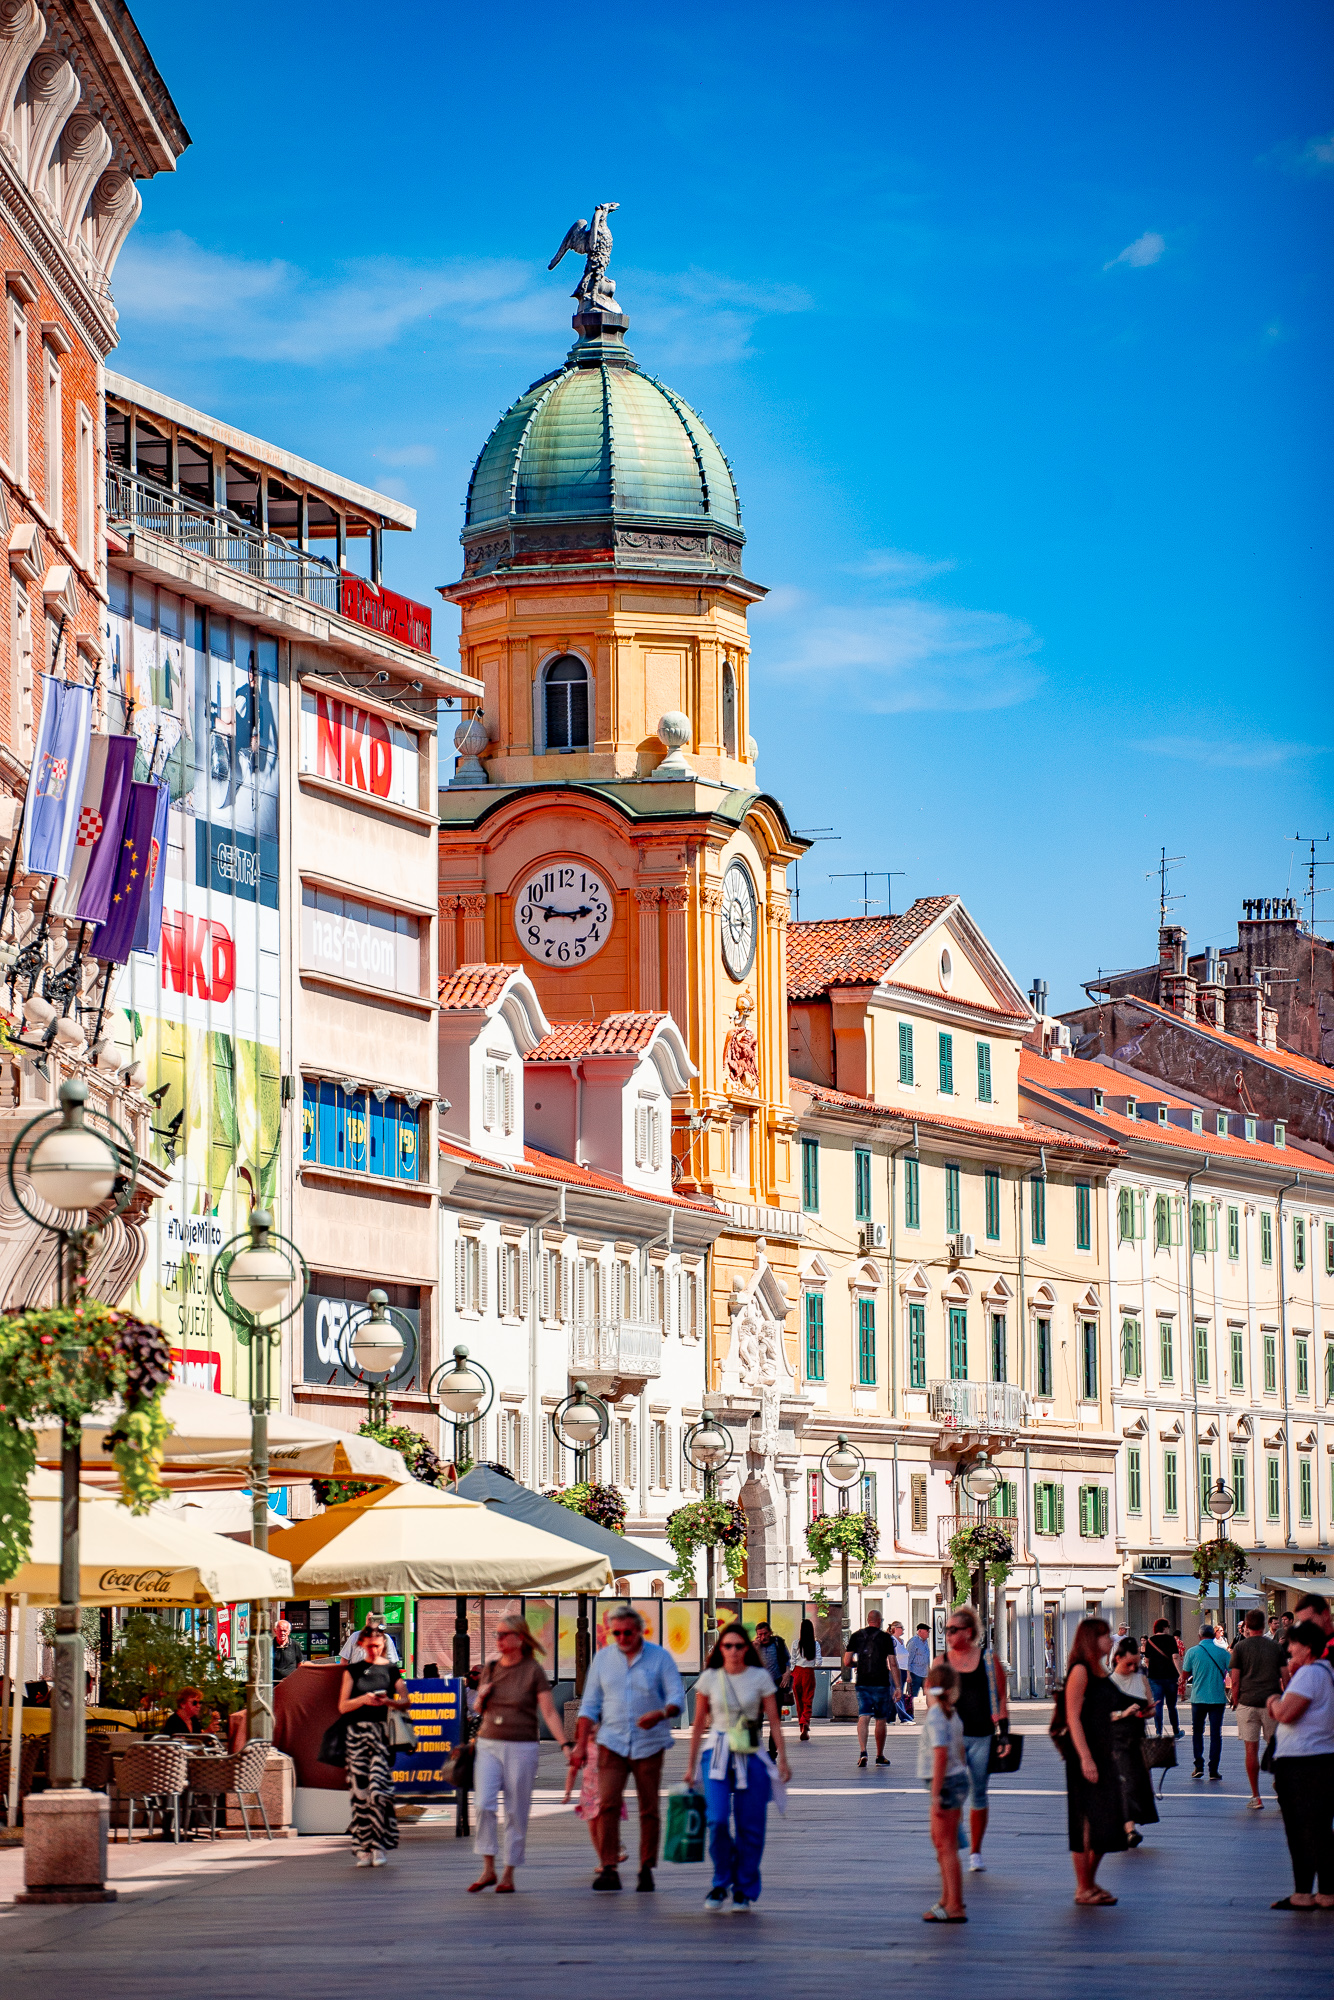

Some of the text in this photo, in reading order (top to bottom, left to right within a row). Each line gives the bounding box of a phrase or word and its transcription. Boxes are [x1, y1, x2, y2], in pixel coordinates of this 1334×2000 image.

[316, 691, 392, 798] NKD
[542, 872, 554, 892] 11
[558, 868, 575, 888] 12
[580, 873, 588, 892] 1
[526, 883, 543, 903] 10
[589, 883, 599, 901] 2
[520, 905, 533, 924] 9
[596, 903, 607, 923] 3
[528, 925, 541, 945] 8
[587, 923, 600, 941] 4
[161, 906, 236, 1003] NKD
[544, 939, 555, 957] 7
[558, 942, 570, 961] 6
[574, 937, 586, 957] 5
[99, 1568, 174, 1593] Coca-Cola
[413, 1725, 442, 1737] STALNI
[423, 1741, 451, 1752] ODNOS
[392, 1770, 409, 1782] 091
[416, 1770, 433, 1782] 477
